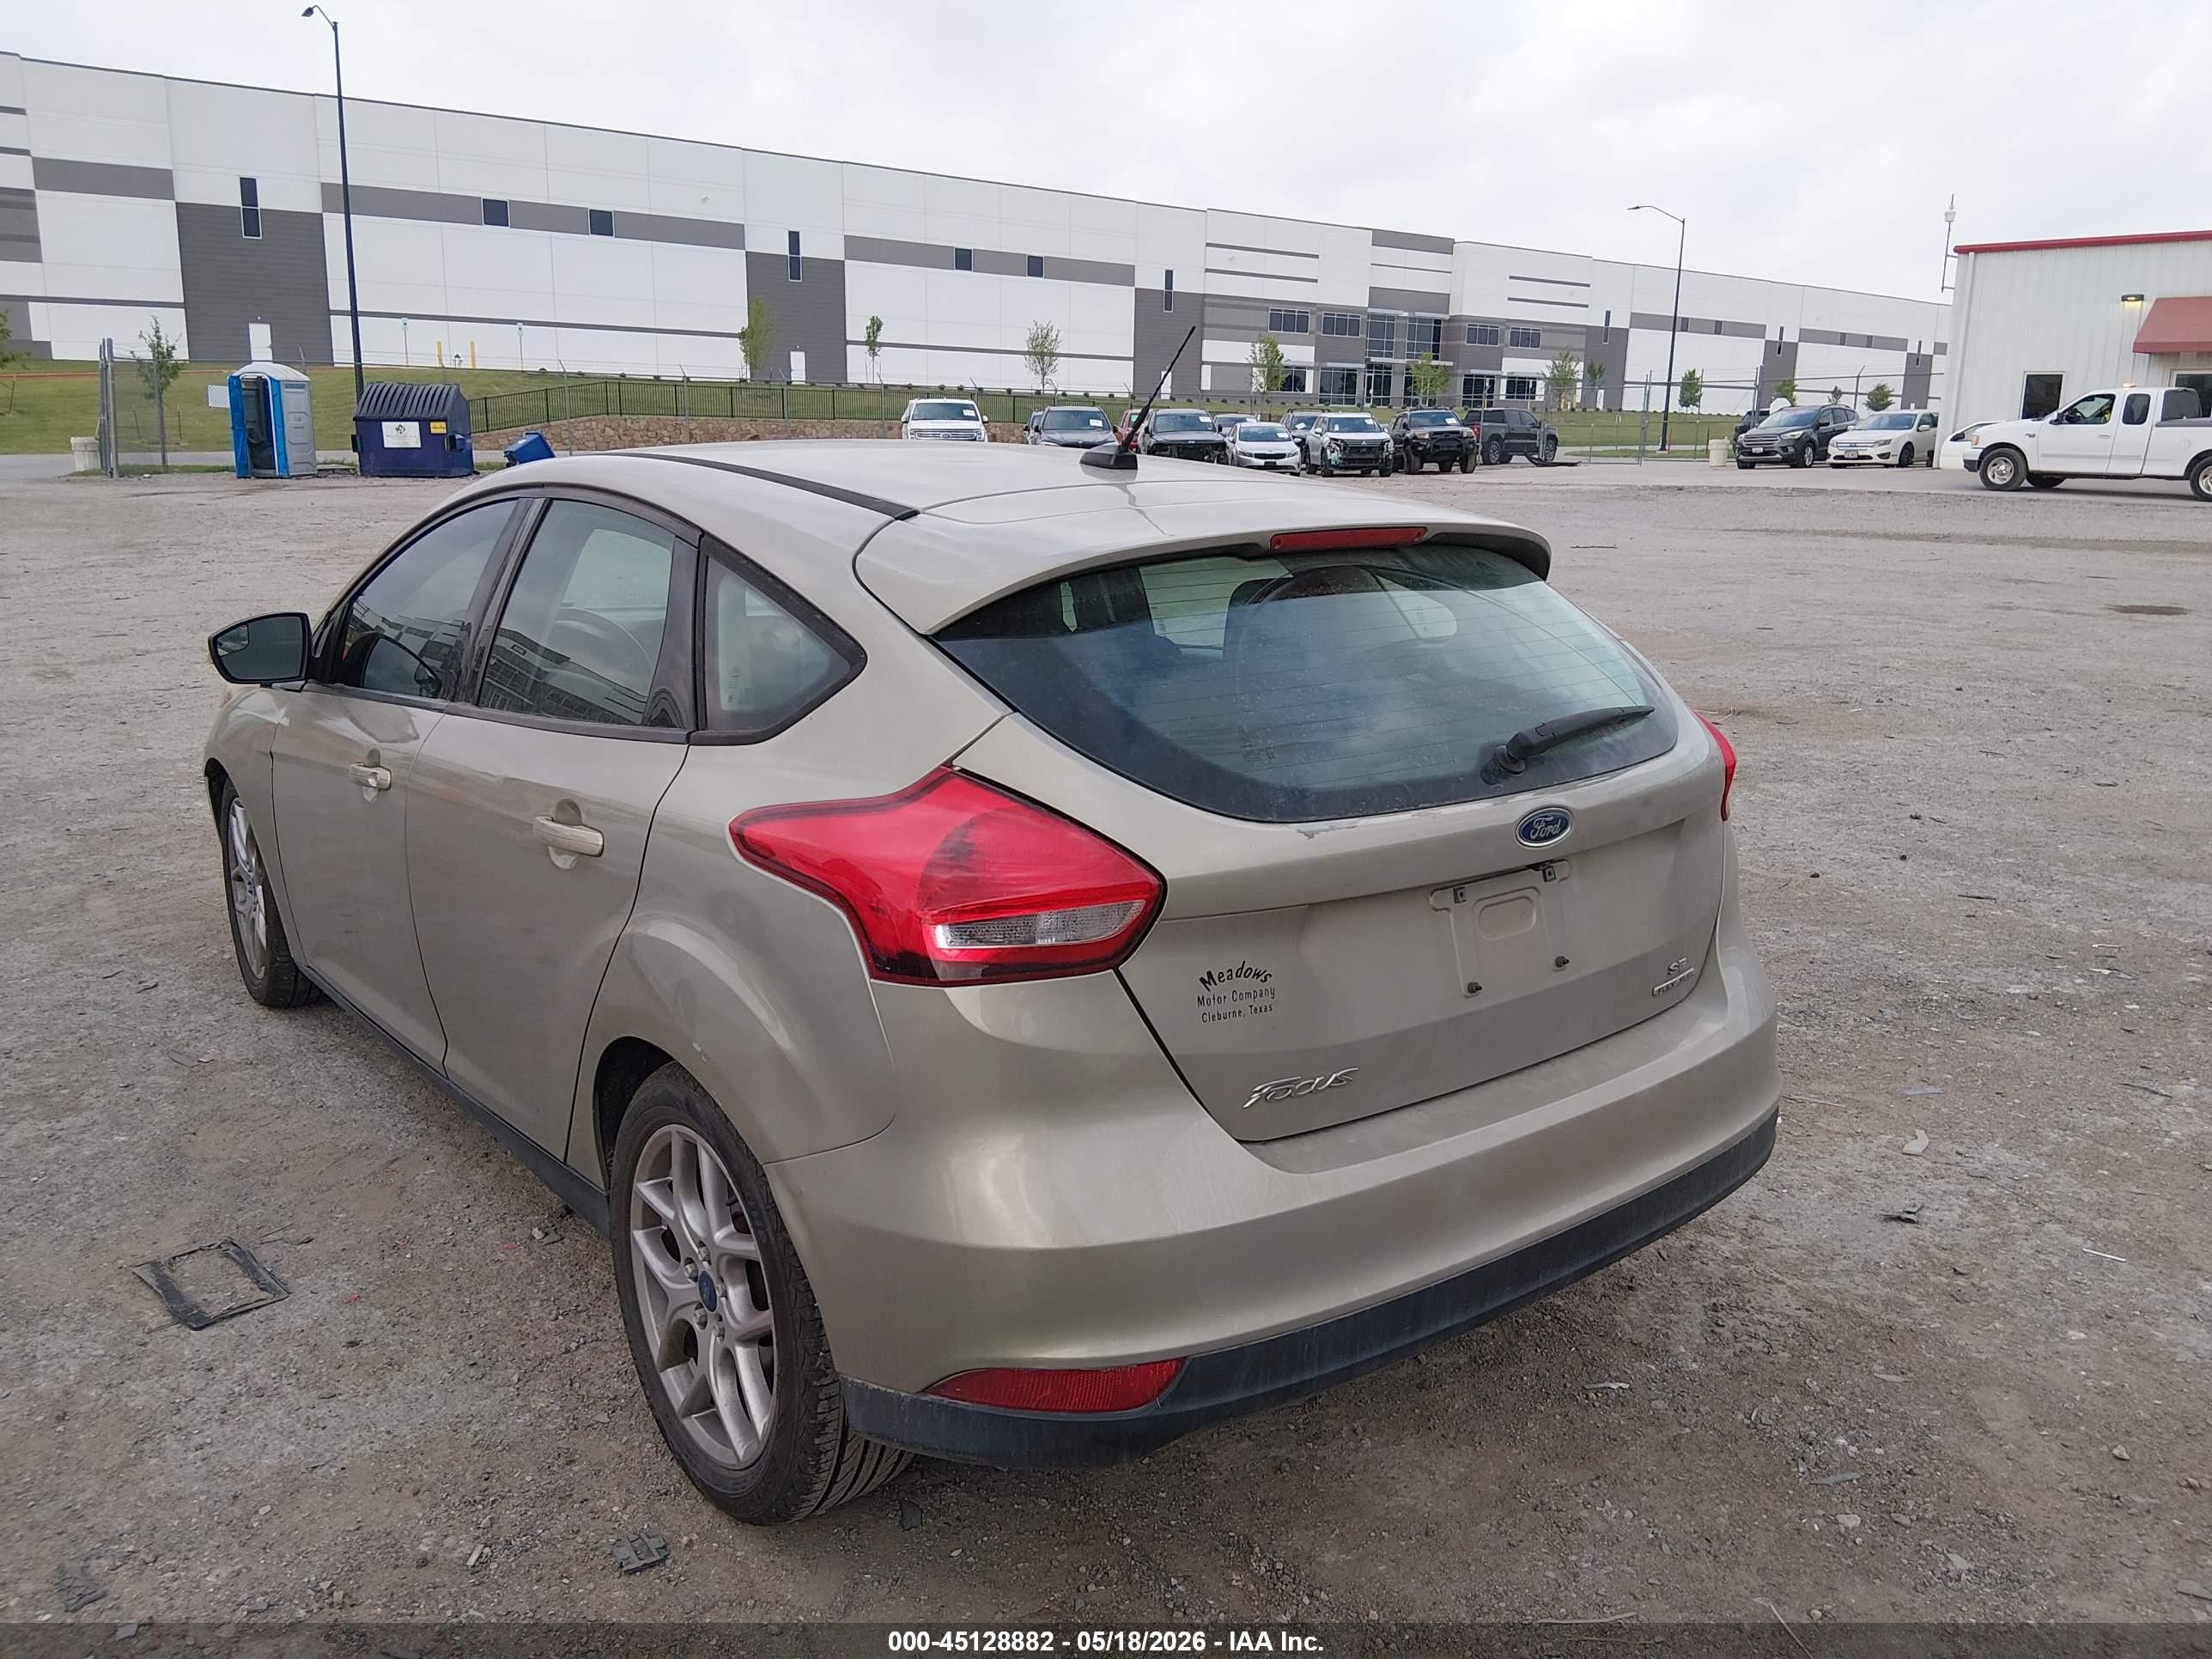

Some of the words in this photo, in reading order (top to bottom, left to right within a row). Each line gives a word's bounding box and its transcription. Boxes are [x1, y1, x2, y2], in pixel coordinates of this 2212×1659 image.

[1529, 816, 1562, 840] Ford
[1199, 960, 1273, 992] Meadows
[1197, 994, 1227, 1008] Motor
[1231, 987, 1275, 1002] Company
[1201, 1010, 1246, 1024] Cleburne,
[1249, 1003, 1273, 1015] Texas
